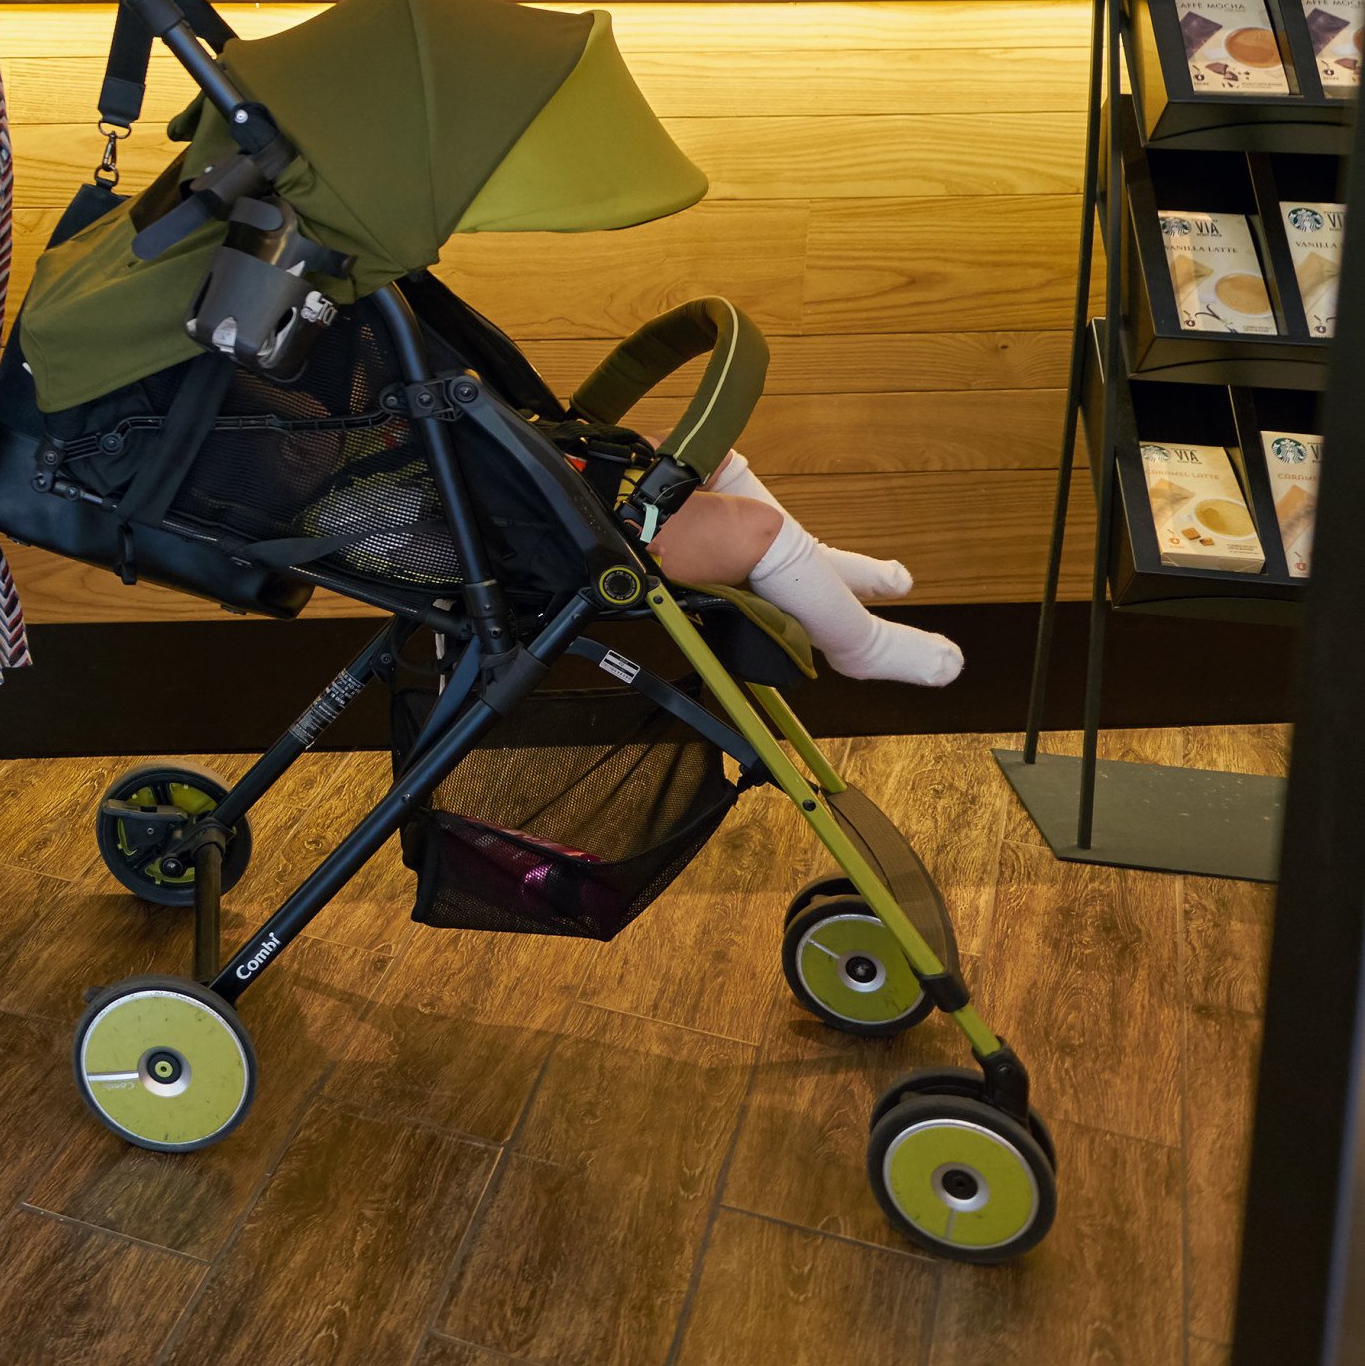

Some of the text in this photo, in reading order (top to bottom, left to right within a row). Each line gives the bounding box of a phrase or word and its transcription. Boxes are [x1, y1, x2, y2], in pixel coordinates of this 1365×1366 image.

[1195, 221, 1219, 234] VIA
[1295, 241, 1337, 249] VANILLA
[1174, 450, 1199, 462] VIA
[1146, 469, 1188, 477] CARAMEL
[236, 932, 281, 979] Combi
